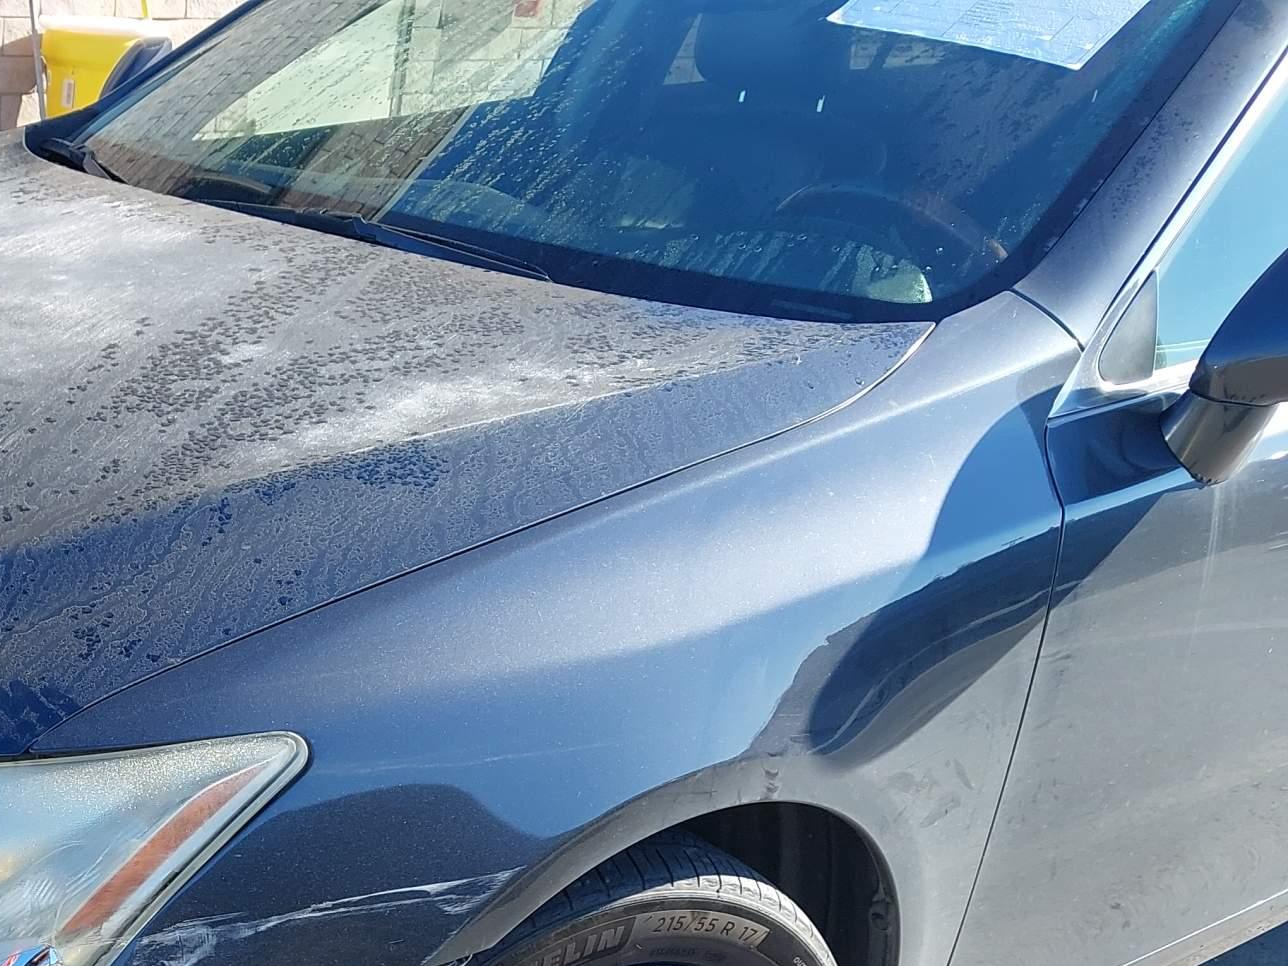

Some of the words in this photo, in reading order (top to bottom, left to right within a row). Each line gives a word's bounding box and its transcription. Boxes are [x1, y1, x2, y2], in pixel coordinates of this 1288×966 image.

[652, 915, 719, 934] 215/55
[720, 922, 736, 937] R
[736, 926, 758, 942] 17
